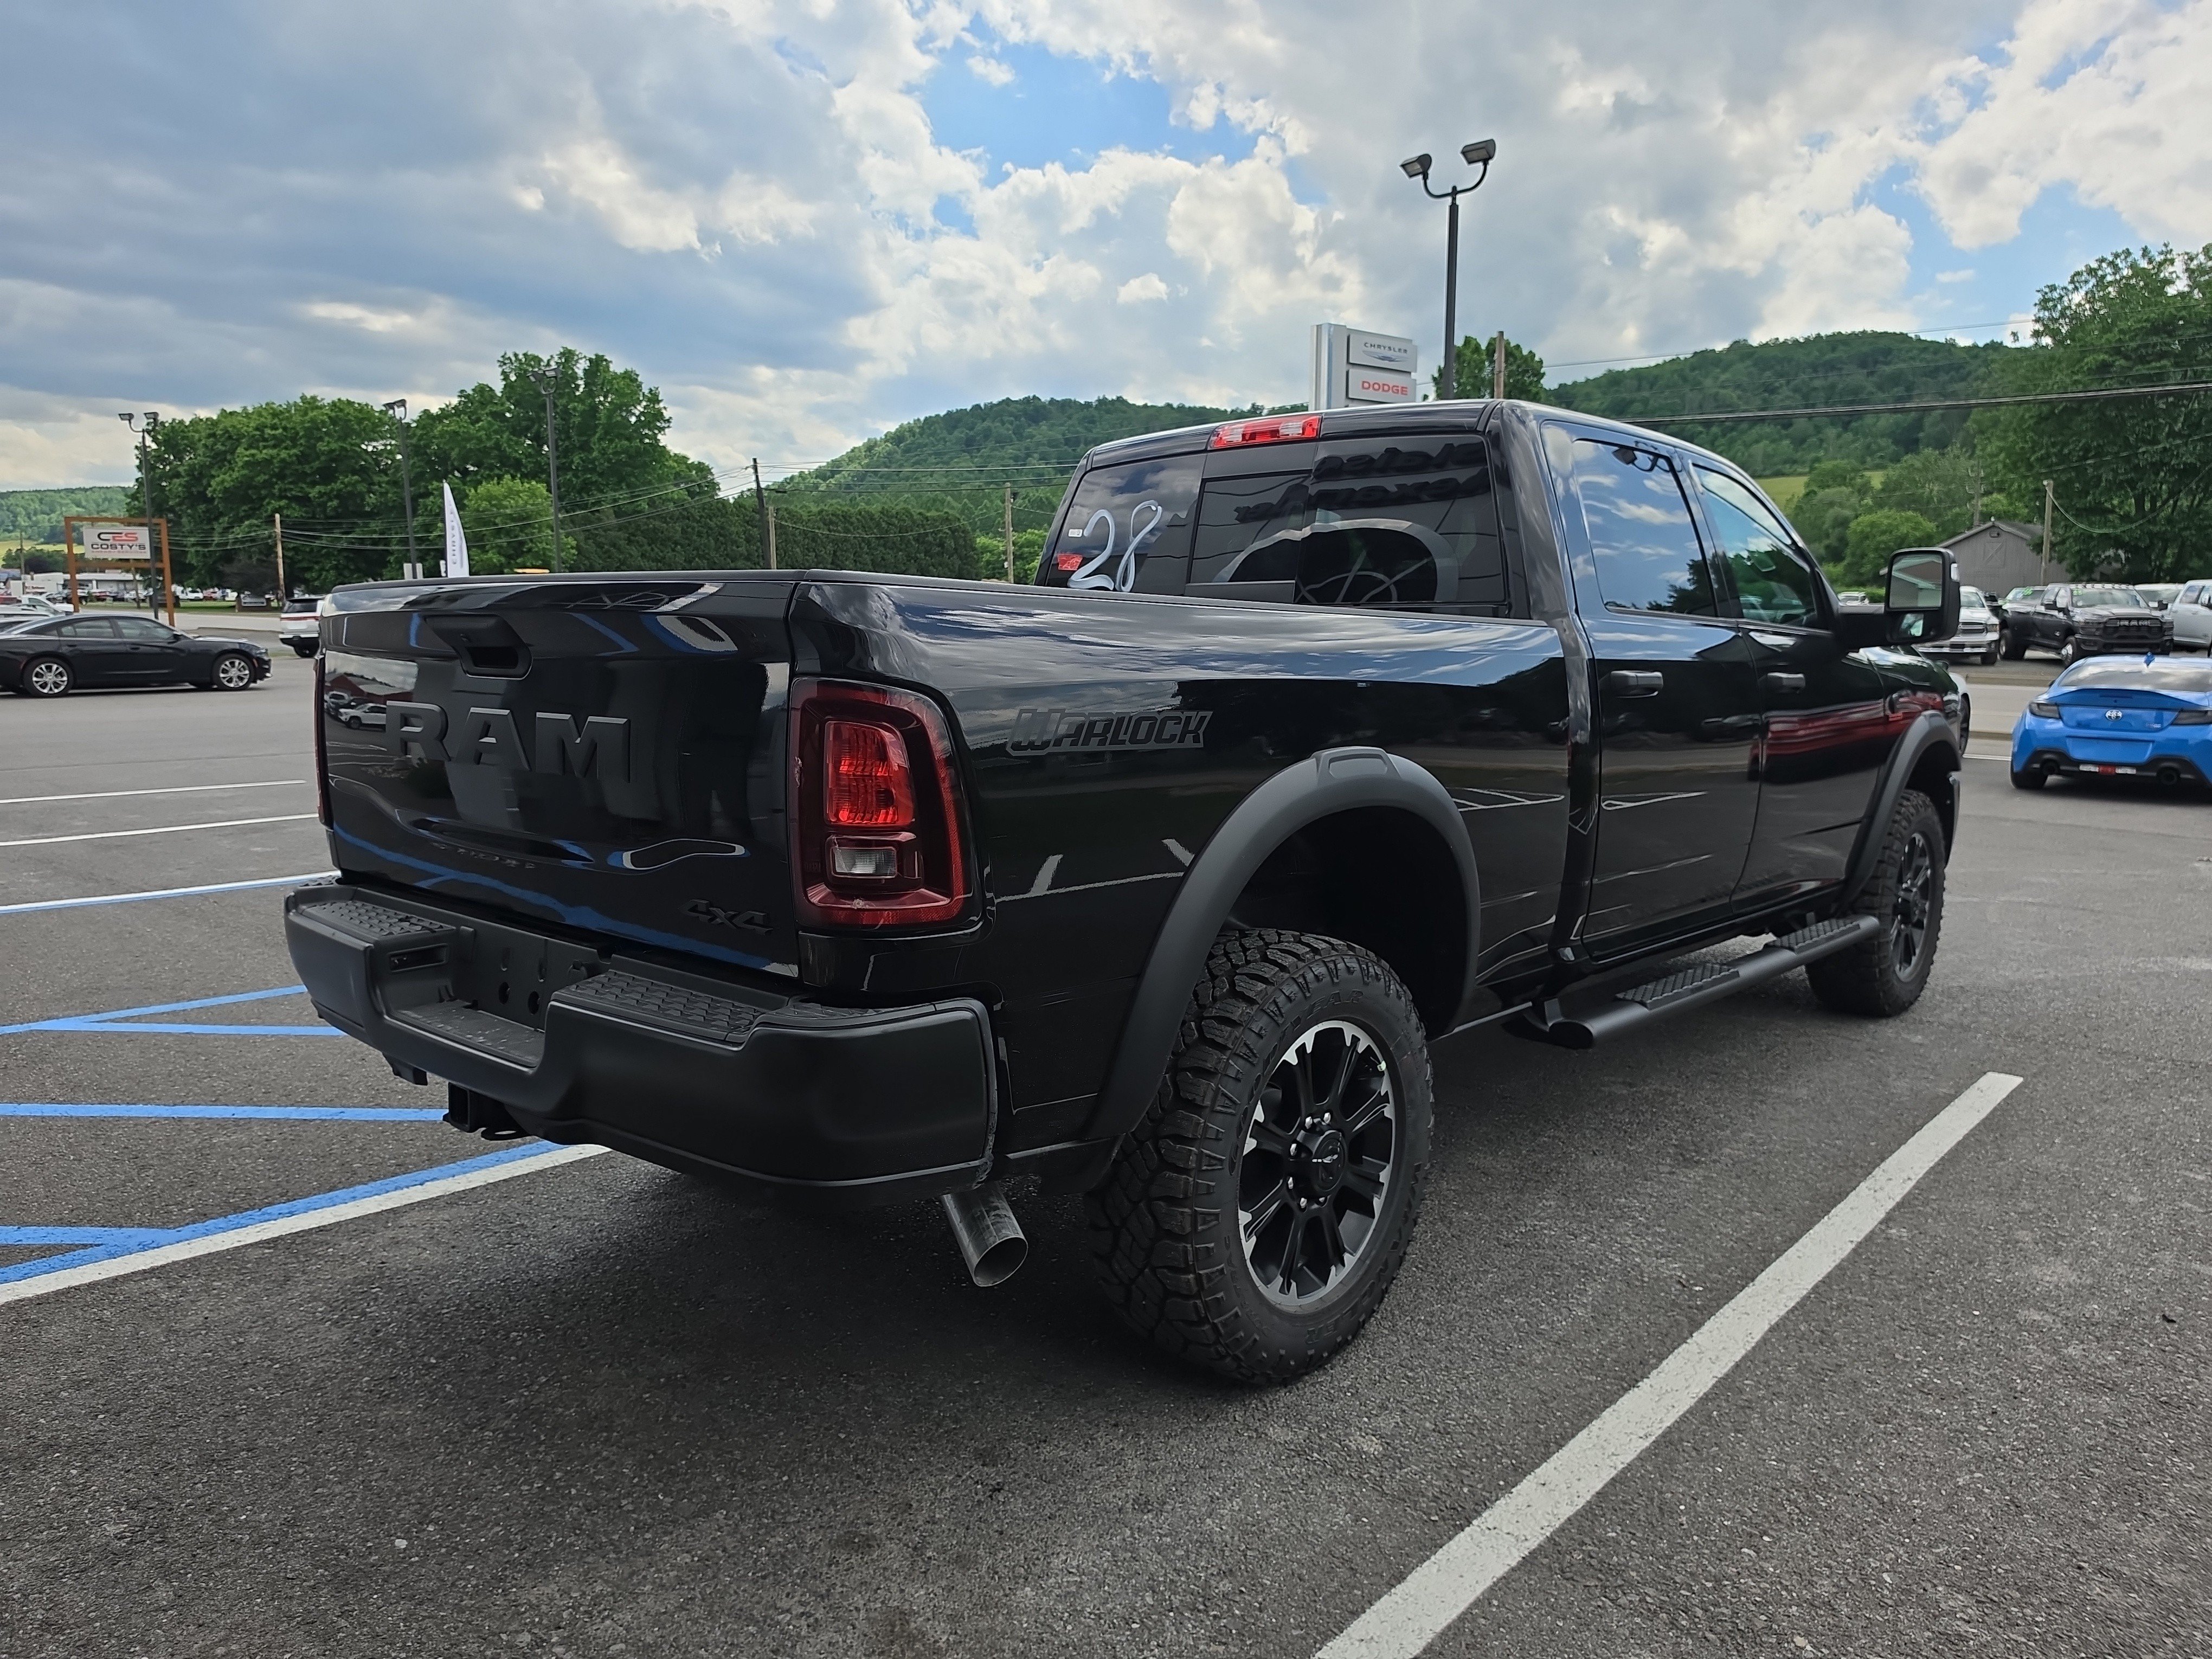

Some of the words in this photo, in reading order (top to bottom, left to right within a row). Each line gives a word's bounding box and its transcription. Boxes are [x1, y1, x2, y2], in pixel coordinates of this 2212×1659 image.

[1363, 342, 1408, 354] CHRYSLER
[1361, 381, 1409, 395] DODGE
[98, 532, 138, 542] CES
[1067, 500, 1162, 593] 28
[386, 700, 631, 783] RAM
[1007, 709, 1212, 756] WARLOCK
[1227, 989, 1364, 1176] GOODYEAR
